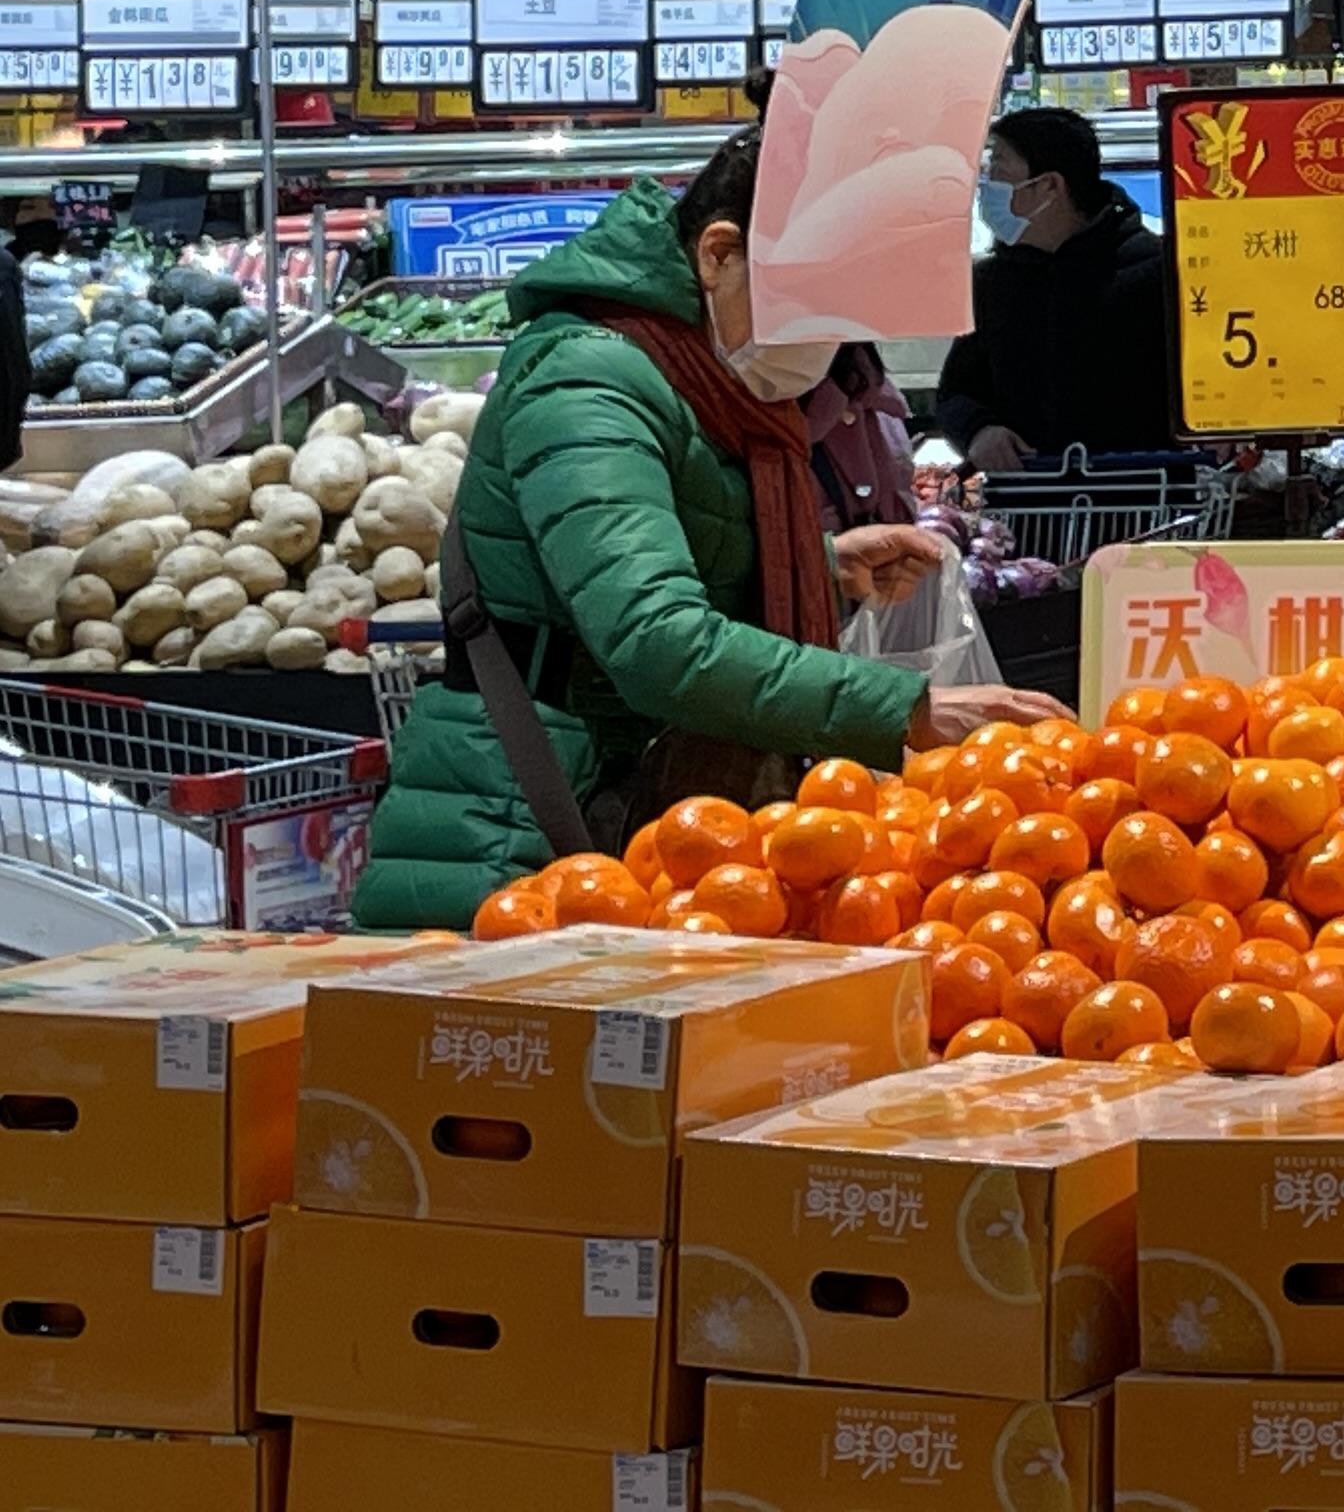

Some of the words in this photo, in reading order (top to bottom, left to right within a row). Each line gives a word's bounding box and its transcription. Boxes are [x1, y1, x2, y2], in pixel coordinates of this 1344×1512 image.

[1244, 231, 1298, 258] 沃柑
[1190, 286, 1208, 316] ¥
[1127, 597, 1344, 679] 沃柑
[430, 1025, 554, 1082] 鲜果时光
[805, 1178, 928, 1237] 鲜果时光
[834, 1421, 963, 1480] 鲜果时光
